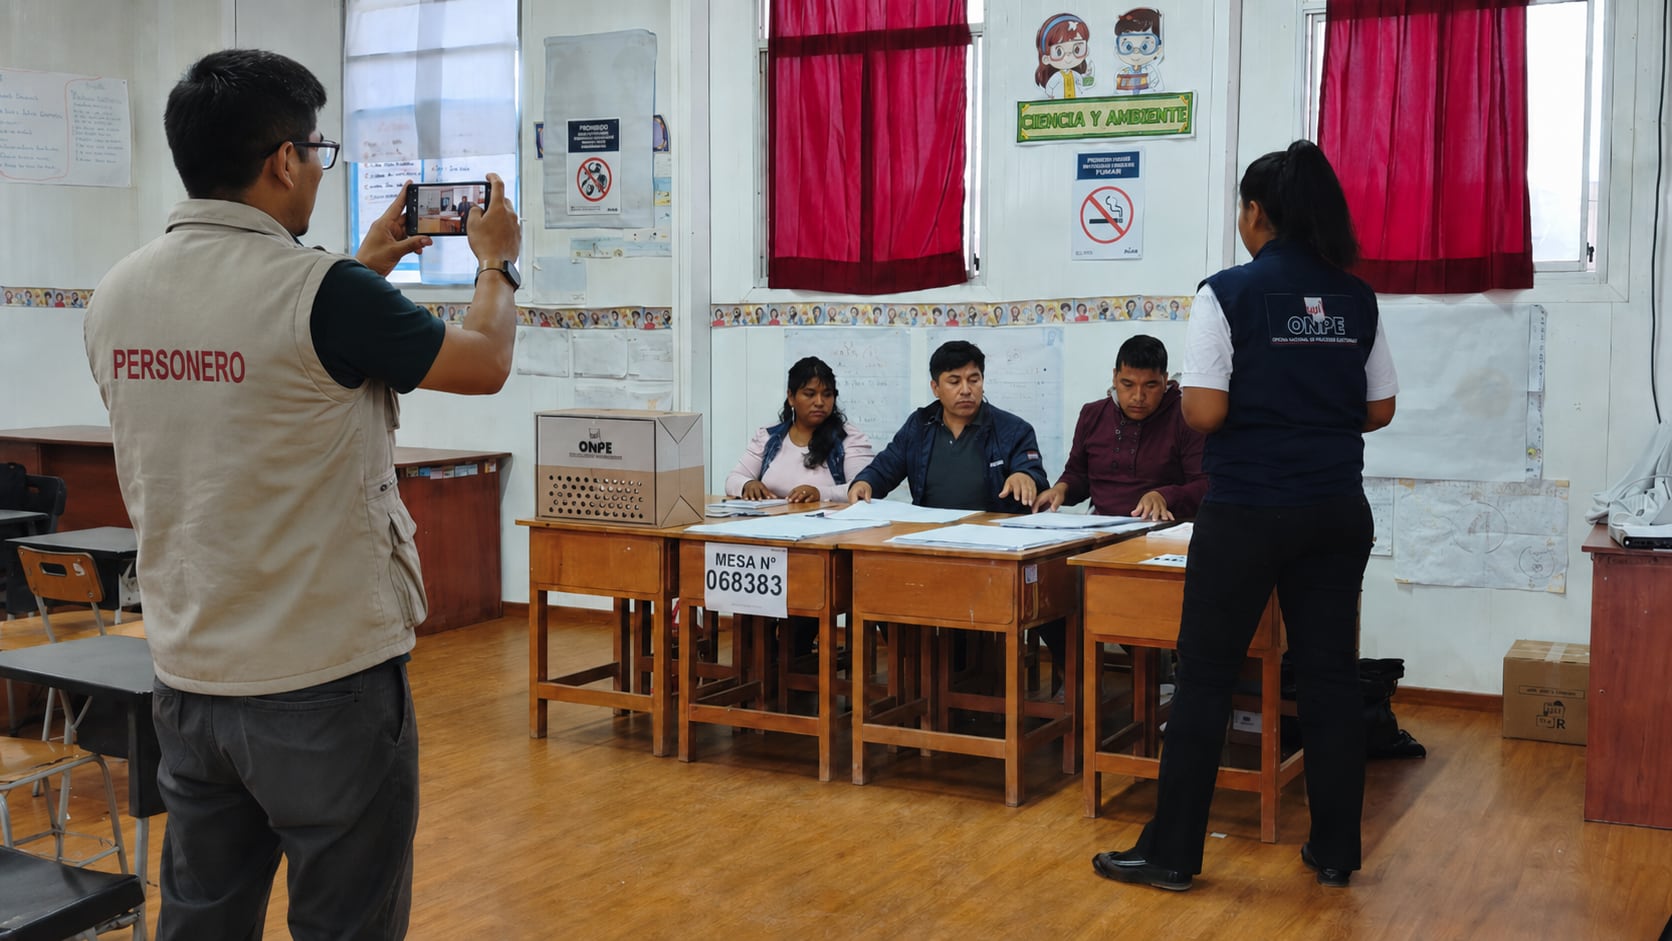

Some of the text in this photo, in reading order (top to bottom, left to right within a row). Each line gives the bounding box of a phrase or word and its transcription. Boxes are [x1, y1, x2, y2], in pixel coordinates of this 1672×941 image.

[1021, 106, 1188, 130] CIENCIA Y AMBIENTE
[1287, 316, 1346, 335] ONPE
[113, 348, 246, 384] PERSONERO
[578, 440, 613, 454] ONPE
[715, 552, 777, 570] MESA N°
[706, 569, 782, 596] 068383
